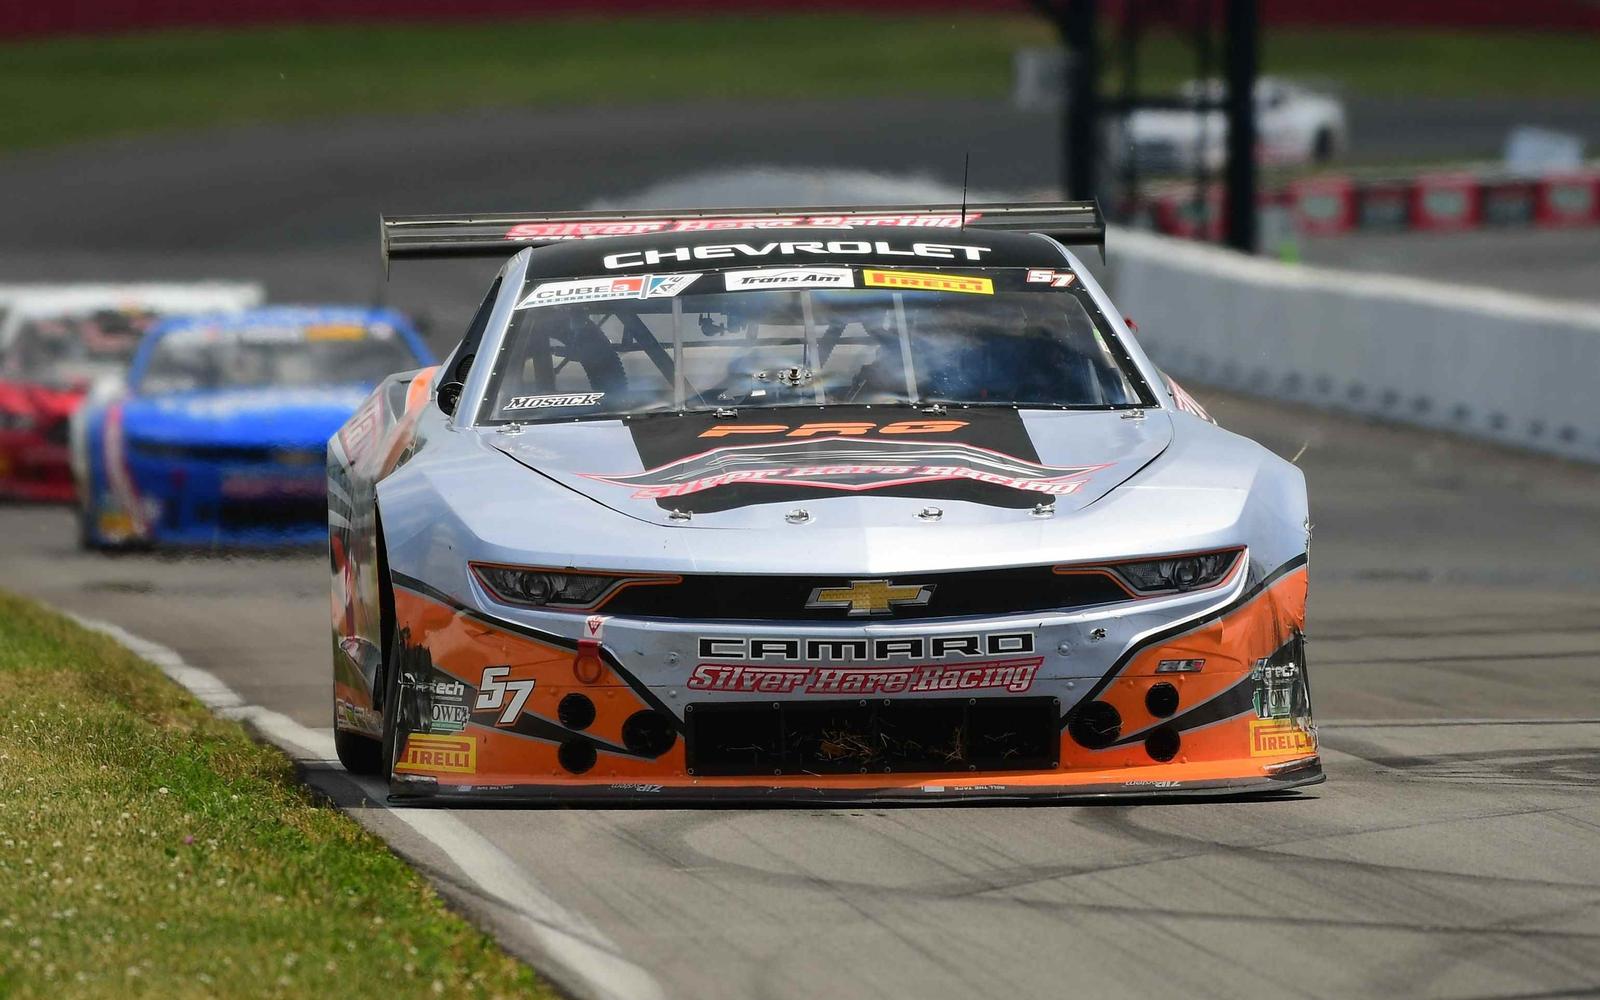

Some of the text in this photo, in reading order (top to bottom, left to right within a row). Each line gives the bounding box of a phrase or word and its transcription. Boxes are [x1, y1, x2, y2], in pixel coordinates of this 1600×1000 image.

[604, 241, 992, 269] CHEVROLET
[739, 272, 841, 285] Trans Am
[872, 272, 984, 292] PIRELLI
[1026, 270, 1075, 287] 57
[697, 420, 970, 437] PRG
[632, 468, 782, 498] Silver
[698, 632, 1035, 660] CAMARO
[688, 656, 1044, 693] Silver Hare Racing
[474, 665, 535, 727] 57
[401, 738, 471, 767] PIRELLI
